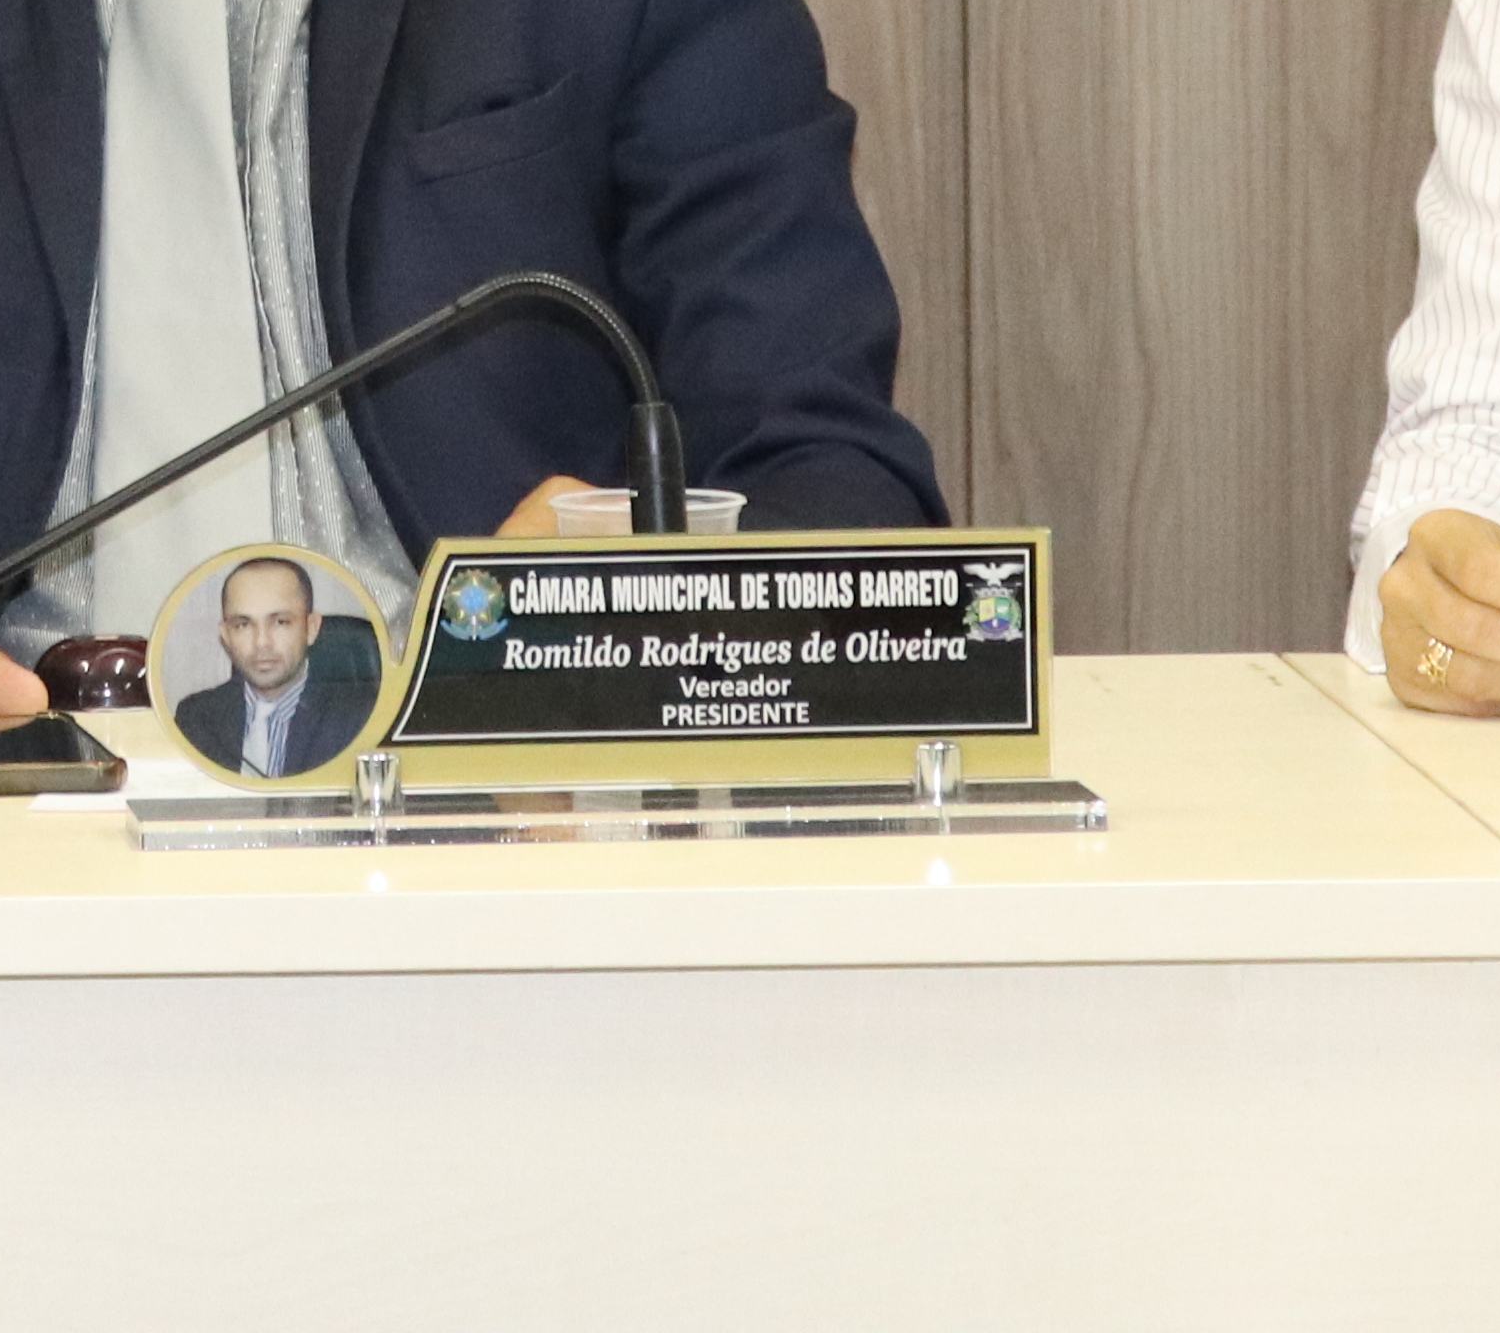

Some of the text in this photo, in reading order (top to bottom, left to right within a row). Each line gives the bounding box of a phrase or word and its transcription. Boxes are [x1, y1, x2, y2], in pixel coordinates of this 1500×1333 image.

[509, 569, 959, 615] CÂMARA MUNICIPAL DE TOBIAS BARRETO
[503, 630, 968, 674] Romildo Rodrigues de Oliveira
[679, 675, 792, 699] Vereador
[661, 701, 810, 728] PRESIDENTE
